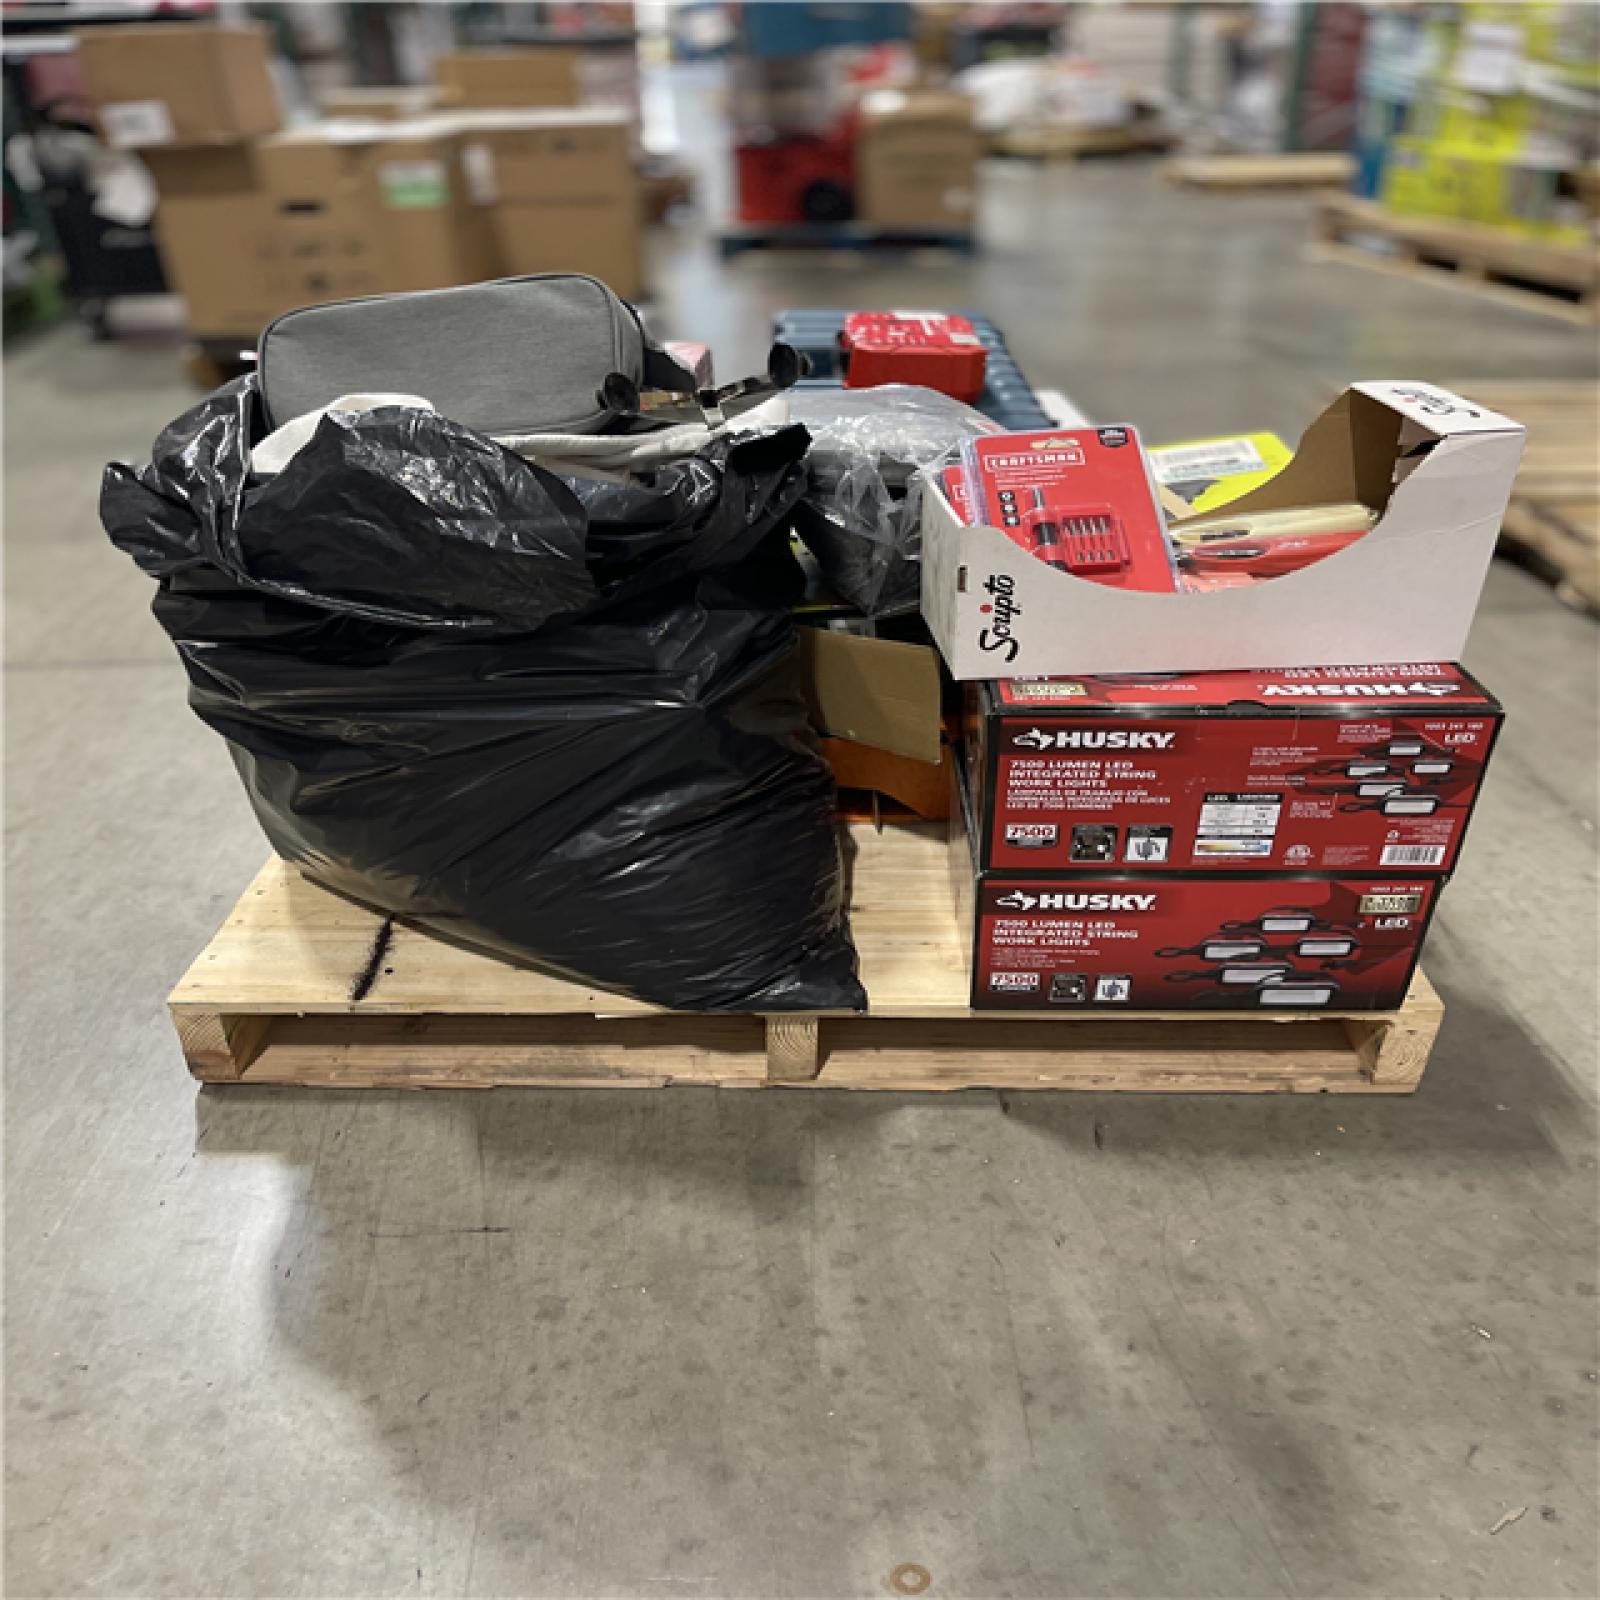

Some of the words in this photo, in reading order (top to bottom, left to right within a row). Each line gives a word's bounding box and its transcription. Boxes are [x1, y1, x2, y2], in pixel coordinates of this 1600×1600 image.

[980, 574, 1022, 663] Scripto
[1056, 732, 1176, 749] HUSKY
[1444, 732, 1476, 744] LED
[1049, 760, 1101, 769] LUMEN
[1104, 761, 1134, 769] LED
[1009, 770, 1101, 779] INTEGRATED
[1104, 770, 1157, 780] STRING
[1008, 780, 1052, 788] WORK
[1056, 780, 1108, 789] LIGHTS
[1039, 894, 1157, 911] HUSKY
[1032, 920, 1084, 929] LUMEN
[1087, 921, 1116, 929] LED
[1375, 917, 1408, 929] LED
[993, 929, 1083, 937] INTEGRATED
[1087, 930, 1139, 939] STRING
[992, 937, 1036, 946] WORK
